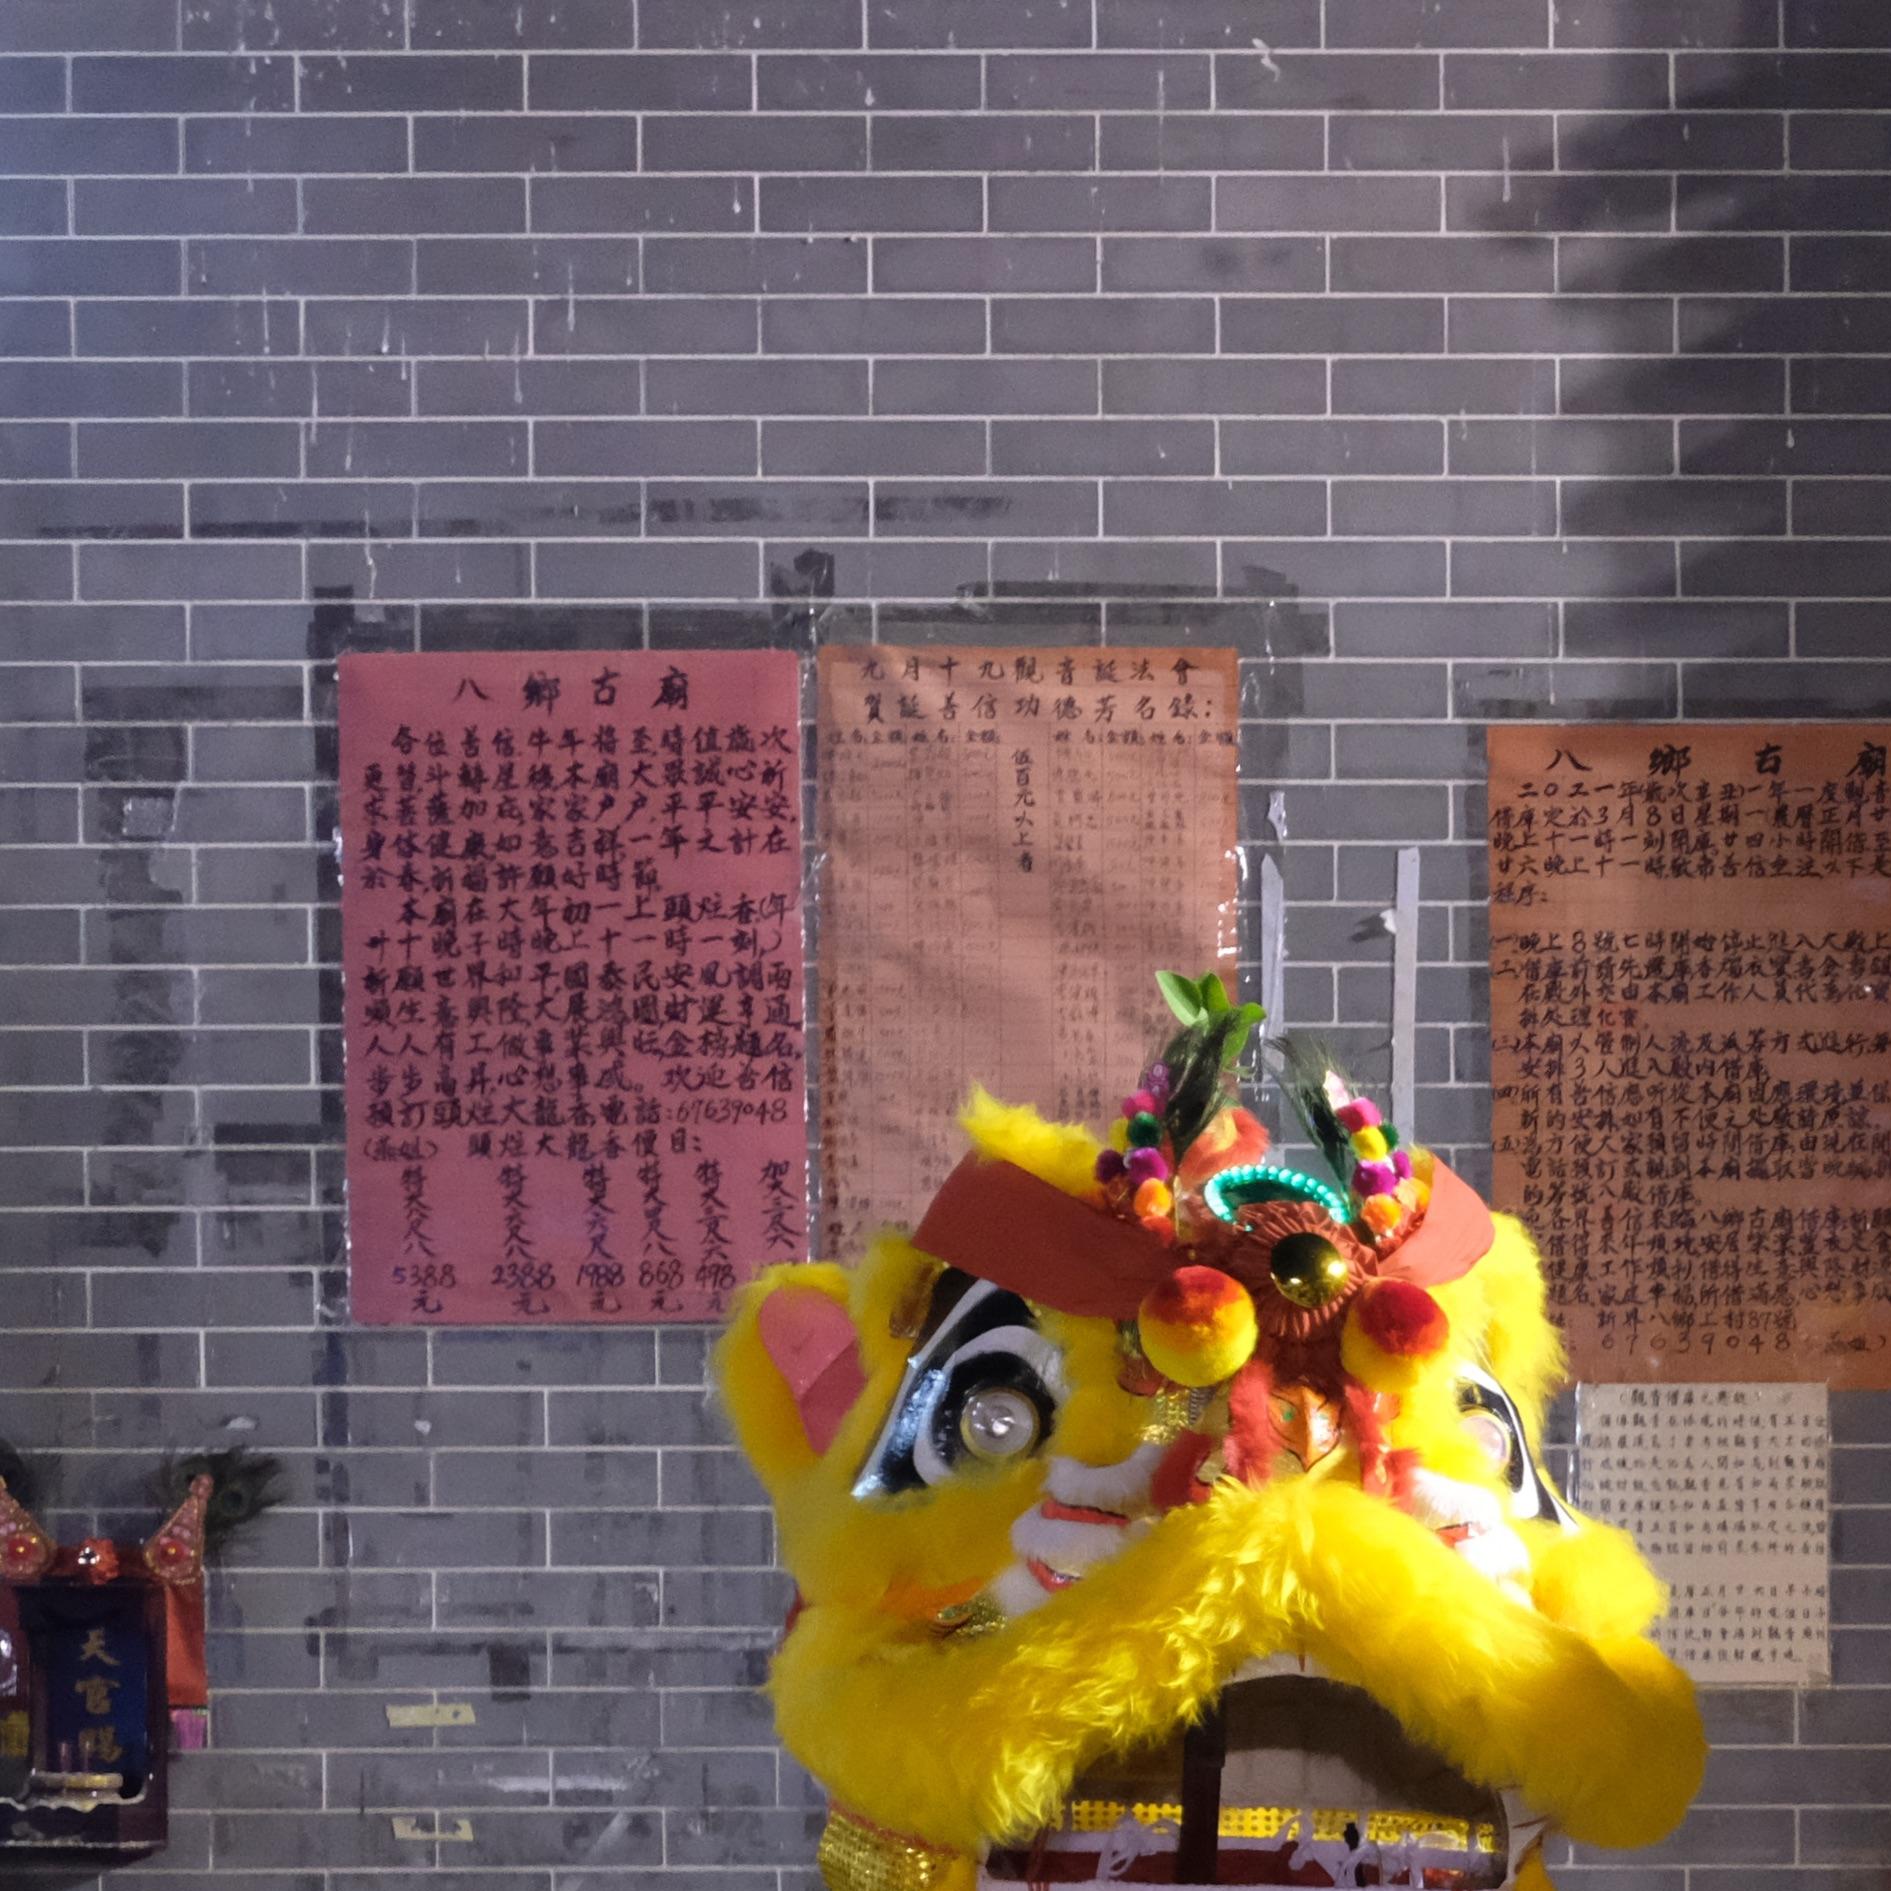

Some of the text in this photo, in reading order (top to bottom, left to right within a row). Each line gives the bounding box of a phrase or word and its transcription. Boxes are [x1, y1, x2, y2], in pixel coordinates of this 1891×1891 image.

[453, 666, 688, 714] 八鄉古廟
[1546, 741, 1888, 781] 八鄉古廟
